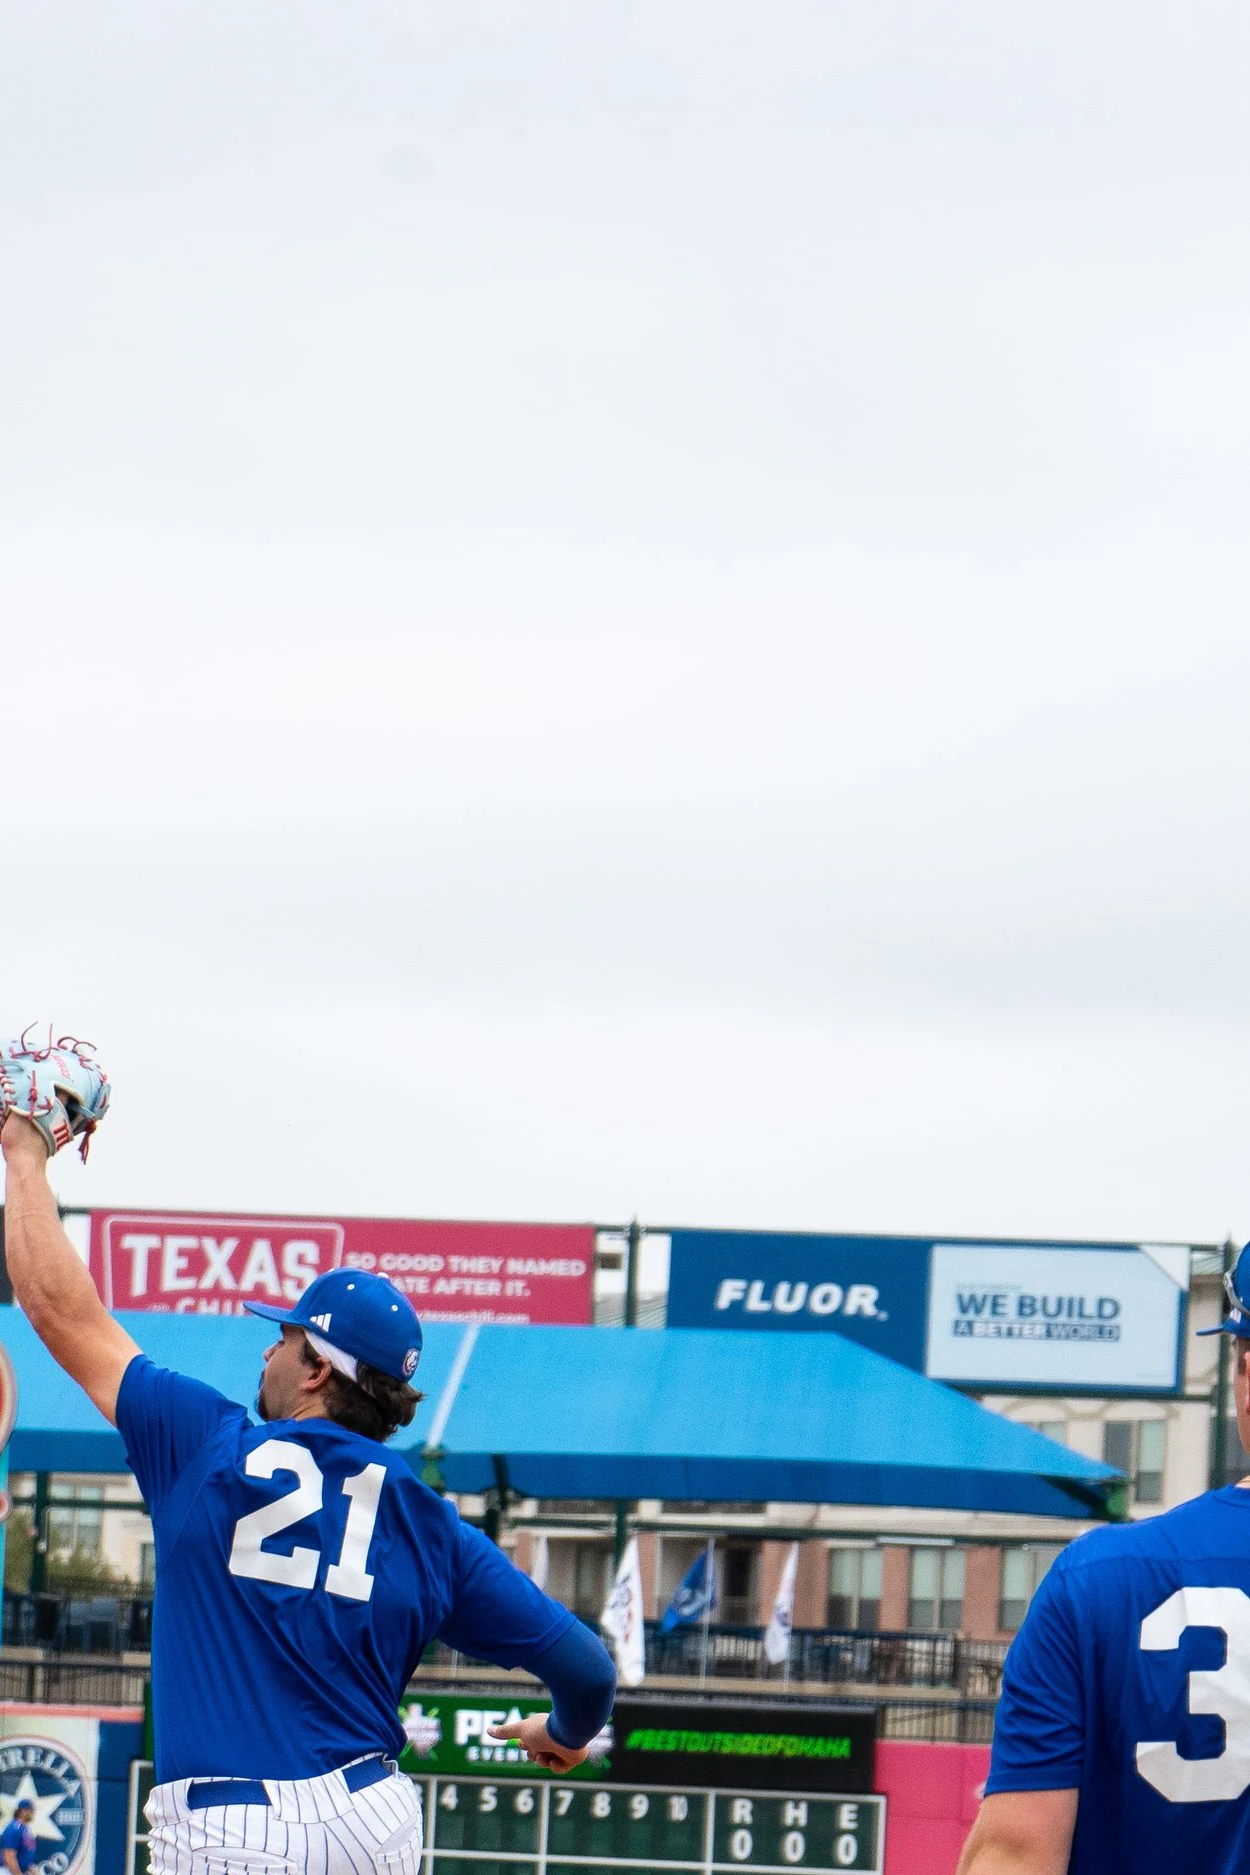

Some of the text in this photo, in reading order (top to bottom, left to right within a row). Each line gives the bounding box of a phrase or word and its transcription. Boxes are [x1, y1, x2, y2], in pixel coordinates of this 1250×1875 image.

[121, 1233, 321, 1302] TEXAS
[379, 1252, 446, 1272] GOOD
[447, 1254, 505, 1274] THEY
[506, 1257, 587, 1277] NAMED
[432, 1276, 503, 1297] AFTER
[956, 1293, 1121, 1320] WE BUILD
[956, 1321, 972, 1337] A
[973, 1322, 1046, 1339] BETTER
[228, 1438, 388, 1602] 21
[1135, 1585, 1250, 1803] 3
[439, 1784, 459, 1811] 4
[478, 1785, 499, 1812] 5
[514, 1787, 535, 1814] 6
[555, 1789, 575, 1816] 7
[590, 1791, 612, 1819] 8
[629, 1793, 650, 1820] 9
[668, 1795, 689, 1821] 10
[731, 1798, 754, 1825] R
[783, 1800, 809, 1827] H
[838, 1803, 859, 1830] E
[731, 1828, 859, 1866] 0 0 0
